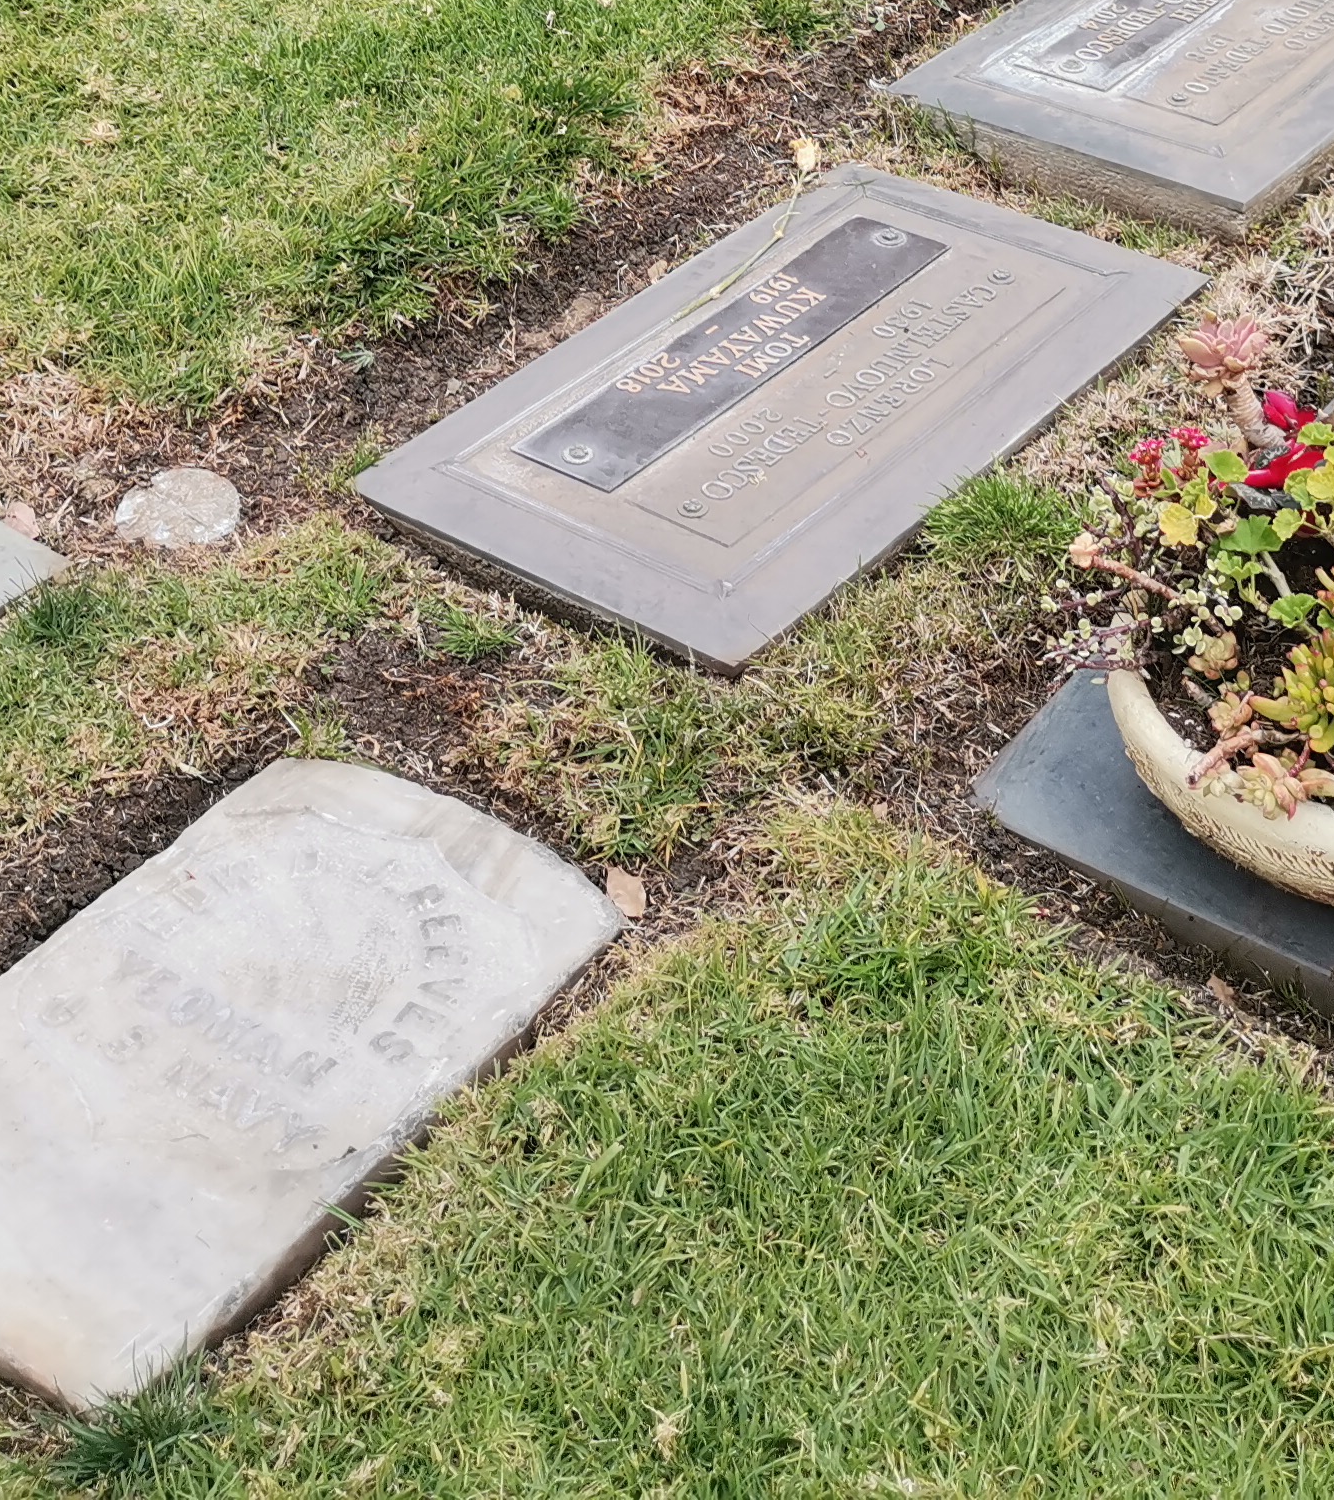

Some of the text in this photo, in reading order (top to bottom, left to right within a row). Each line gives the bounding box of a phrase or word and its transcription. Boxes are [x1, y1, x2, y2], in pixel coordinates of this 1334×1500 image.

[1079, 3, 1130, 32] 2014
[749, 272, 799, 306] 1919
[615, 352, 682, 394] 2018
[655, 287, 827, 397] KUWAYAMA
[733, 330, 812, 379] TOMI
[707, 407, 785, 458] 2000
[825, 357, 953, 447] LORENZO
[368, 883, 470, 1064] REEVES
[111, 949, 338, 1088] YEOMAN
[162, 1055, 331, 1155] NAVY
